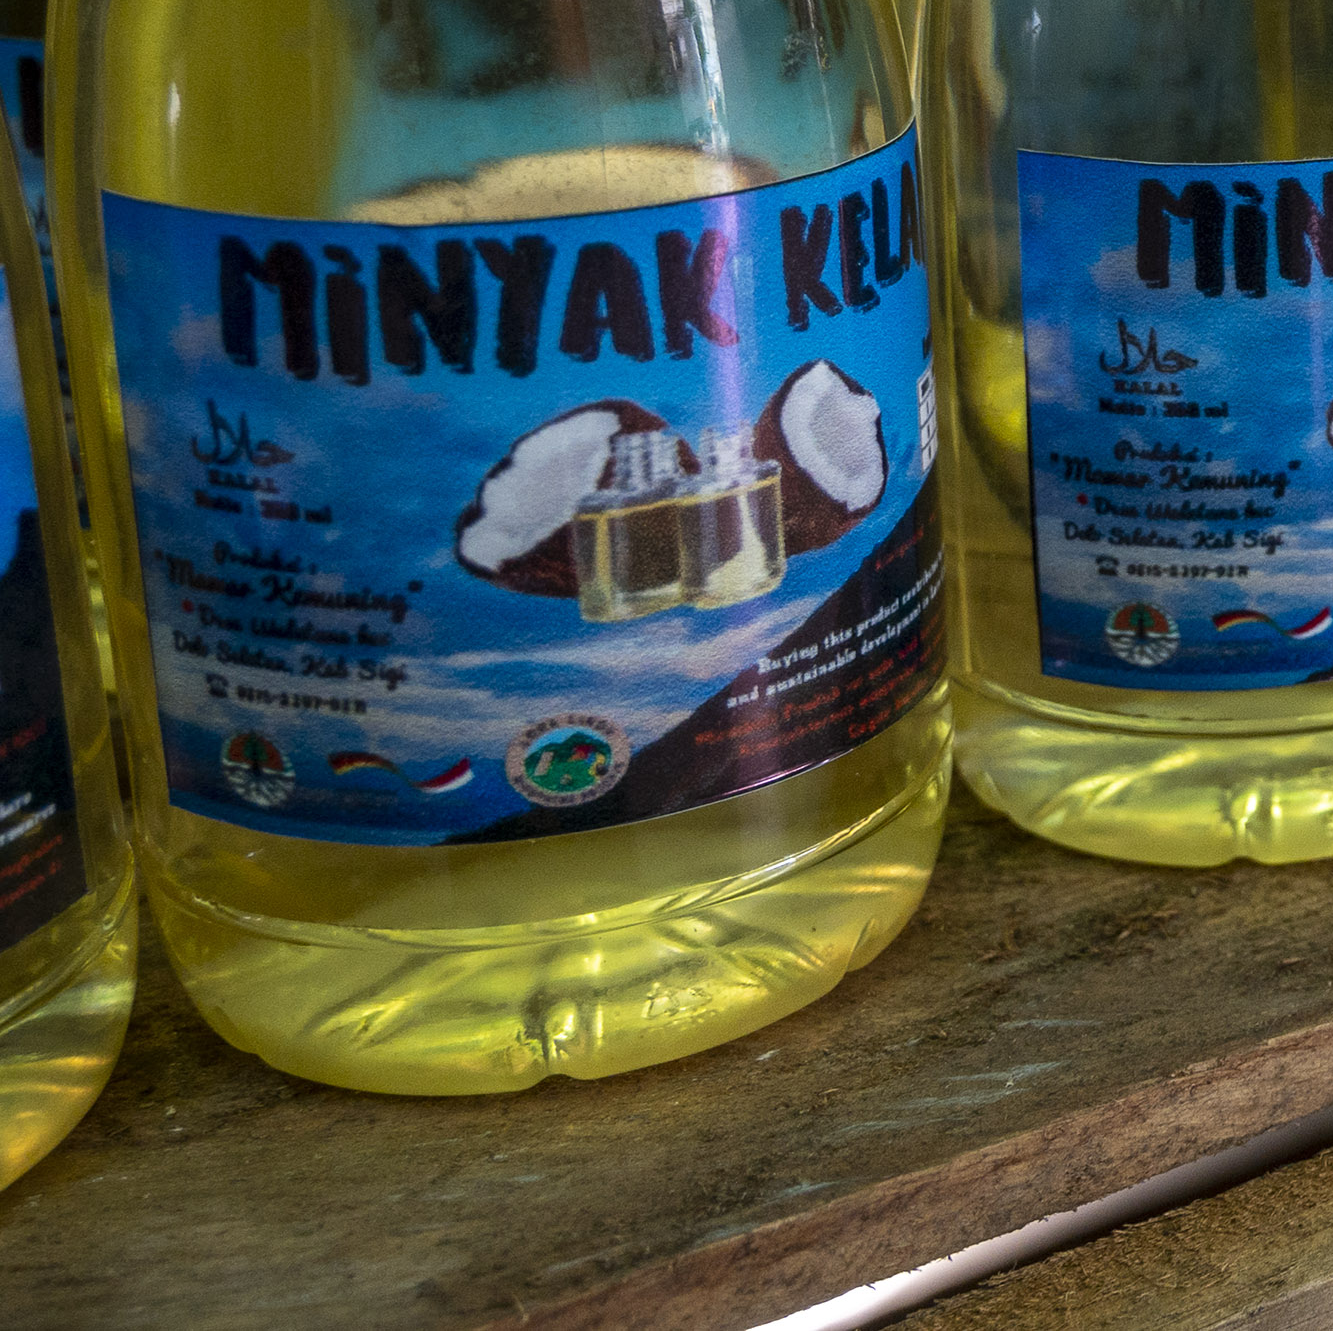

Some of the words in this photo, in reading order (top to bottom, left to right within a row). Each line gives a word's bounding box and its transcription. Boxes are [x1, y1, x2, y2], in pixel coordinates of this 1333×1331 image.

[726, 686, 760, 710] and
[765, 647, 857, 696] sustainable
[860, 603, 921, 655] development
[756, 644, 819, 675] Buying
[823, 625, 853, 649] this
[855, 598, 900, 639] product
